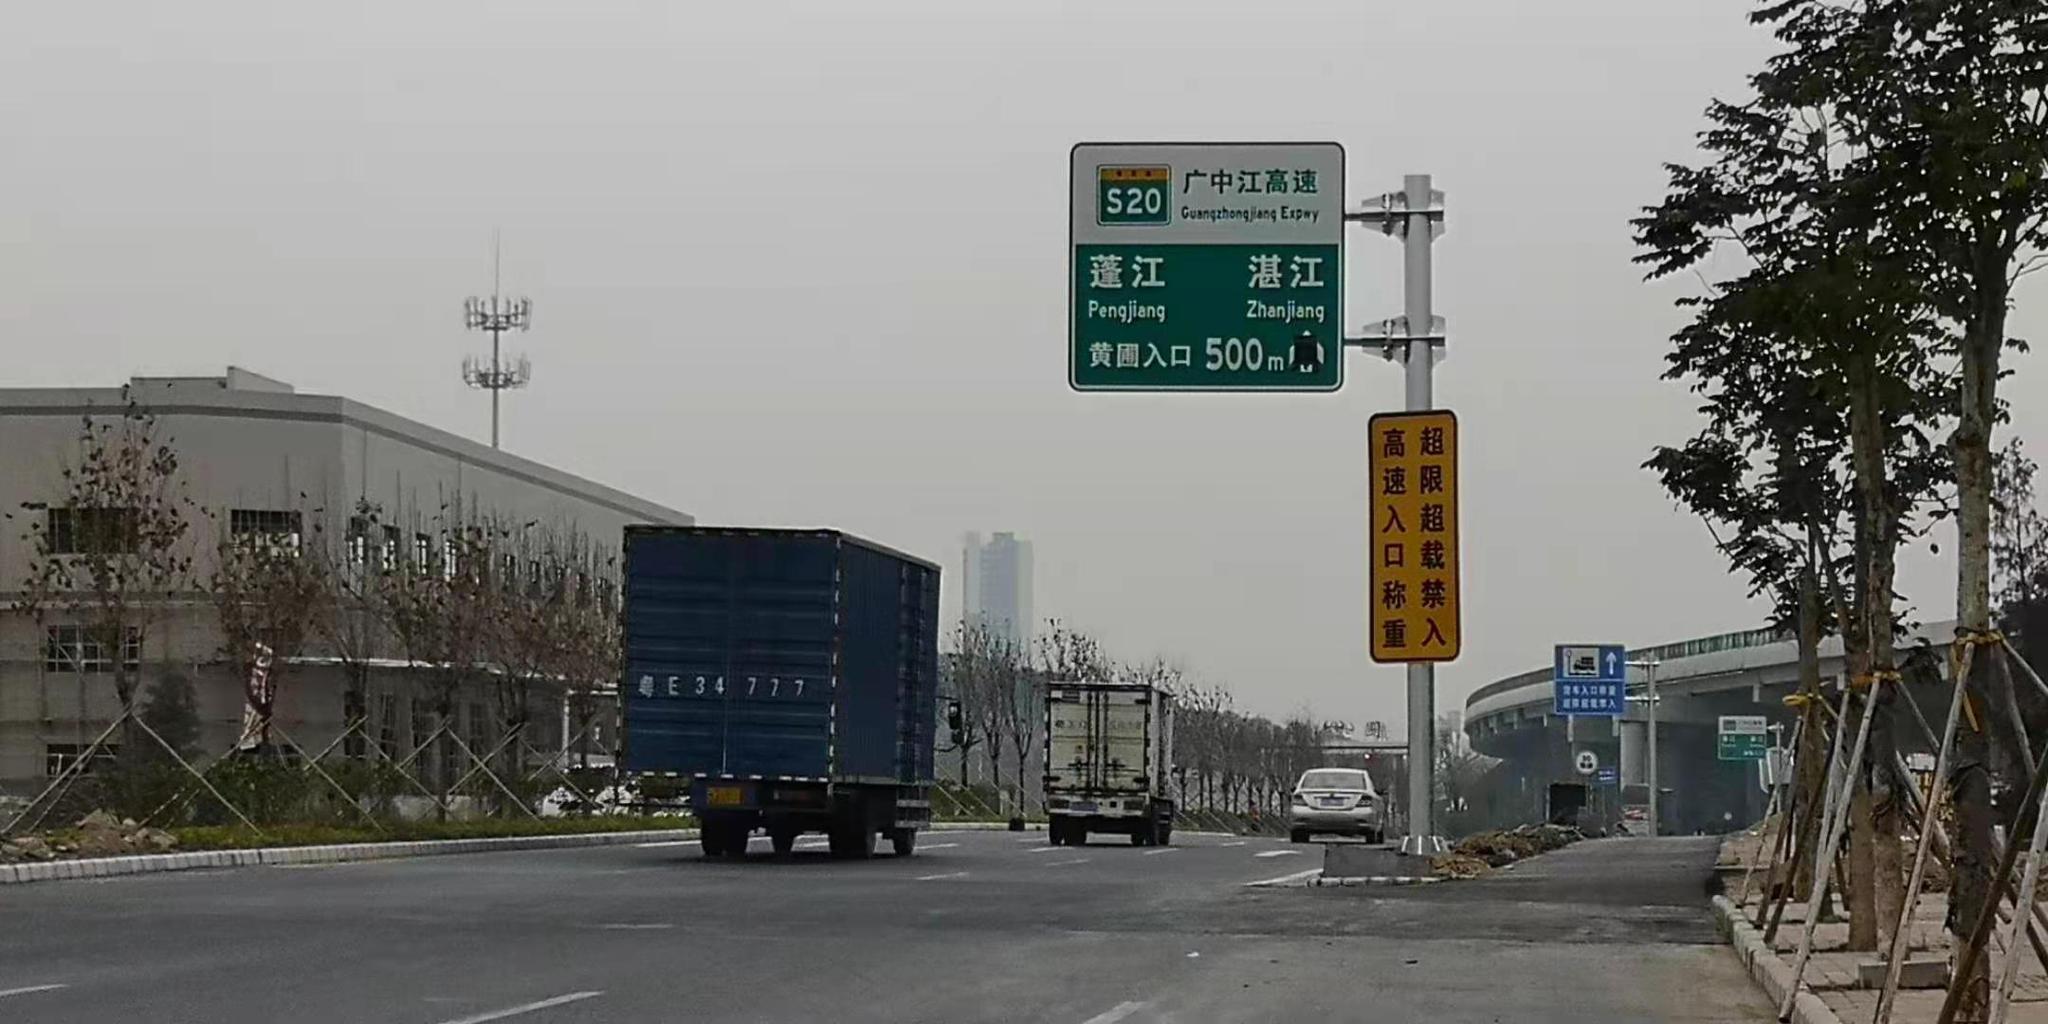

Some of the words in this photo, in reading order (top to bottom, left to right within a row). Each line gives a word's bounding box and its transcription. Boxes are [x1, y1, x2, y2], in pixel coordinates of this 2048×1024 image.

[1183, 168, 1318, 194] 广中江高速
[1106, 187, 1161, 214] S20
[1181, 205, 1277, 223] Guangzhongjiang
[1280, 205, 1319, 224] Expwy
[1089, 254, 1165, 288] 蓬江
[1248, 254, 1324, 288] 湛江
[1088, 300, 1165, 323] Pengjiang
[1246, 300, 1325, 323] Zhanjiang
[1089, 342, 1191, 368] 黄圃入口
[1382, 427, 1407, 649] 高速入口称重
[1419, 425, 1447, 648] 超限超载禁入
